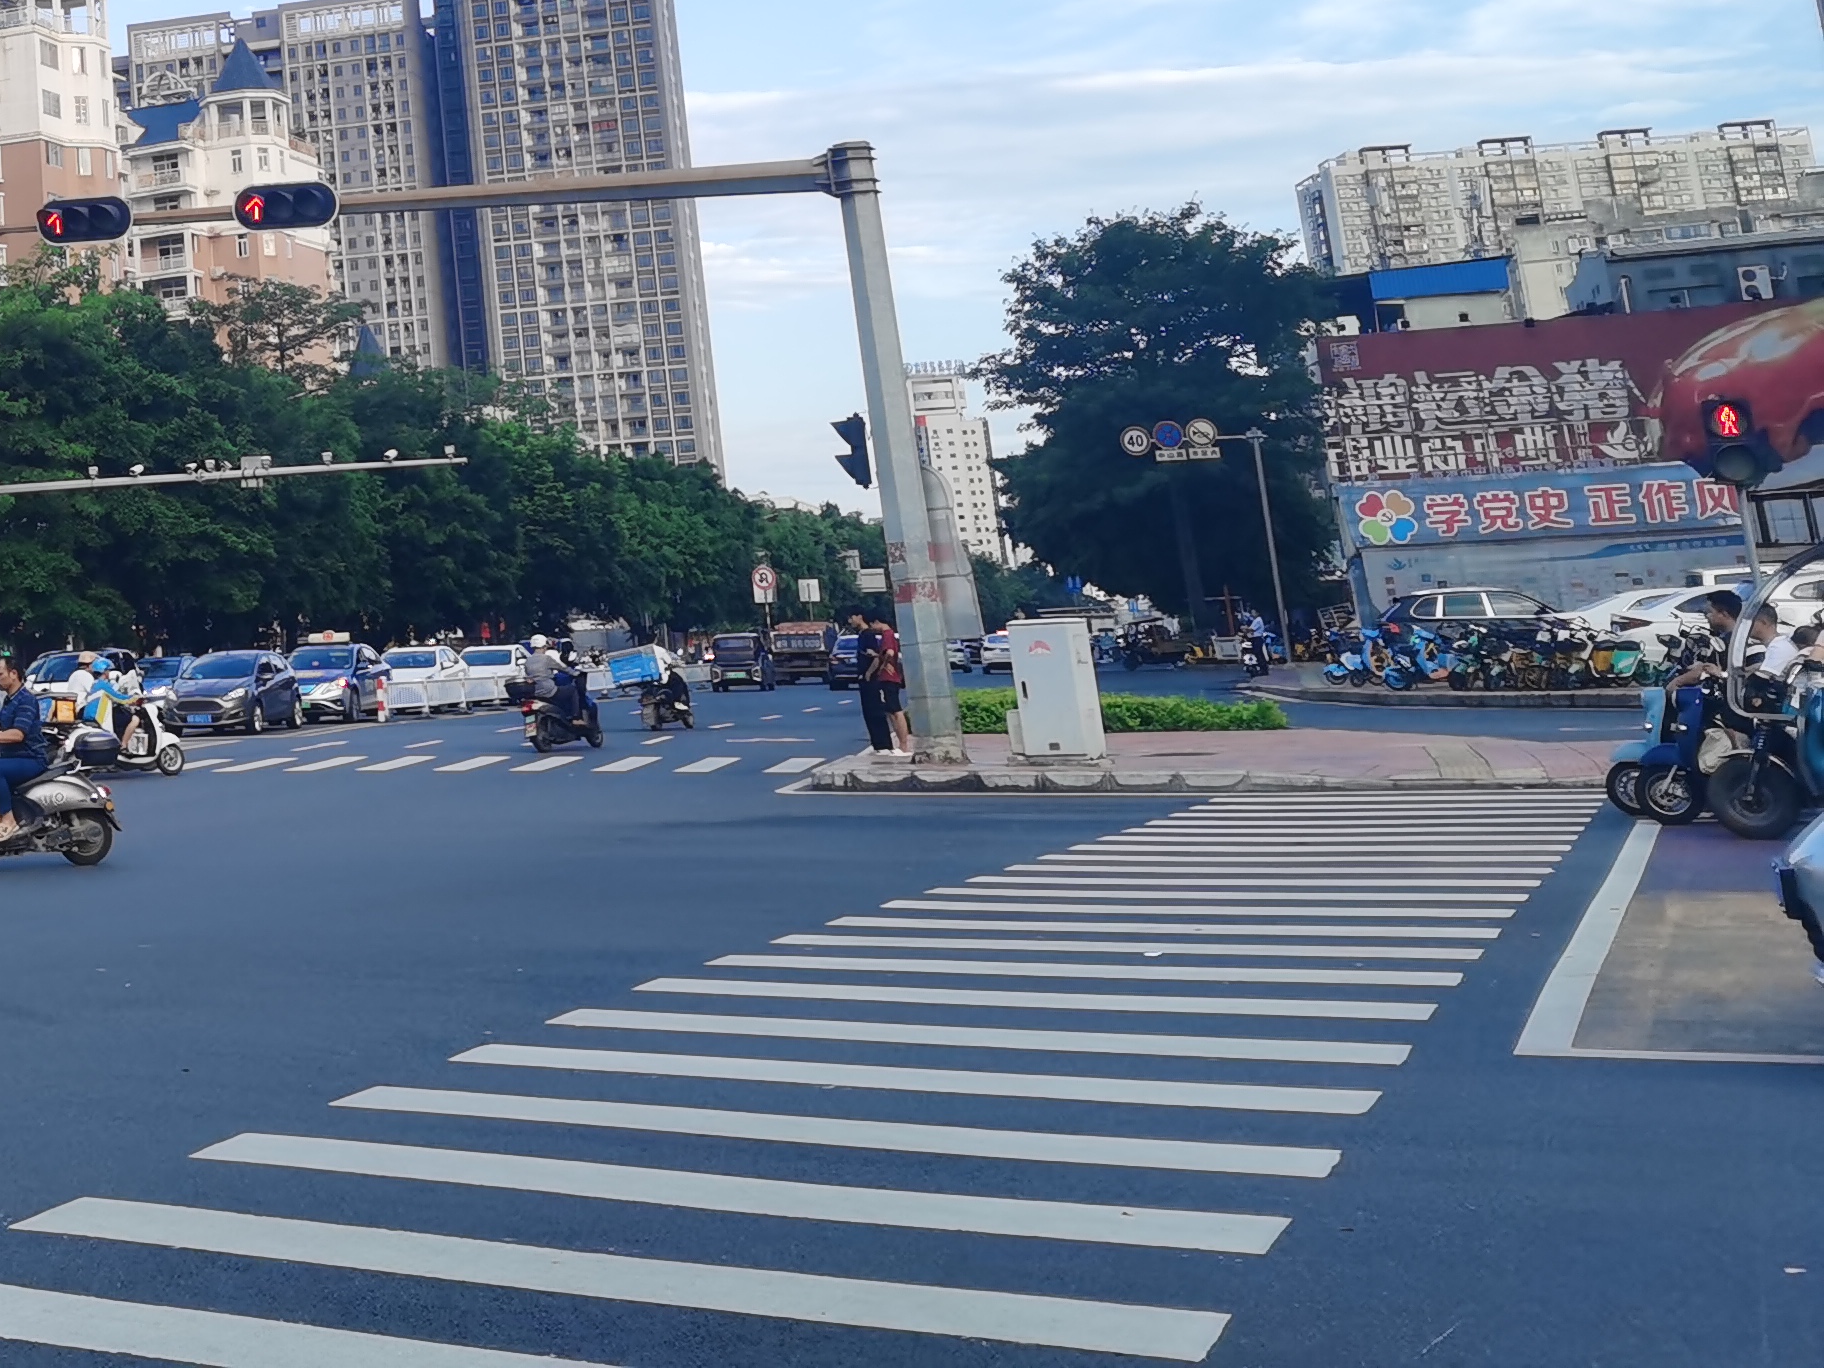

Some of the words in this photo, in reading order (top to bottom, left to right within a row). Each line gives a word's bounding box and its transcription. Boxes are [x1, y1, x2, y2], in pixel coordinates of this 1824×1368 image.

[1127, 435, 1144, 448] 40
[1423, 486, 1575, 537] 学党史
[1584, 477, 1739, 526] 正作风
